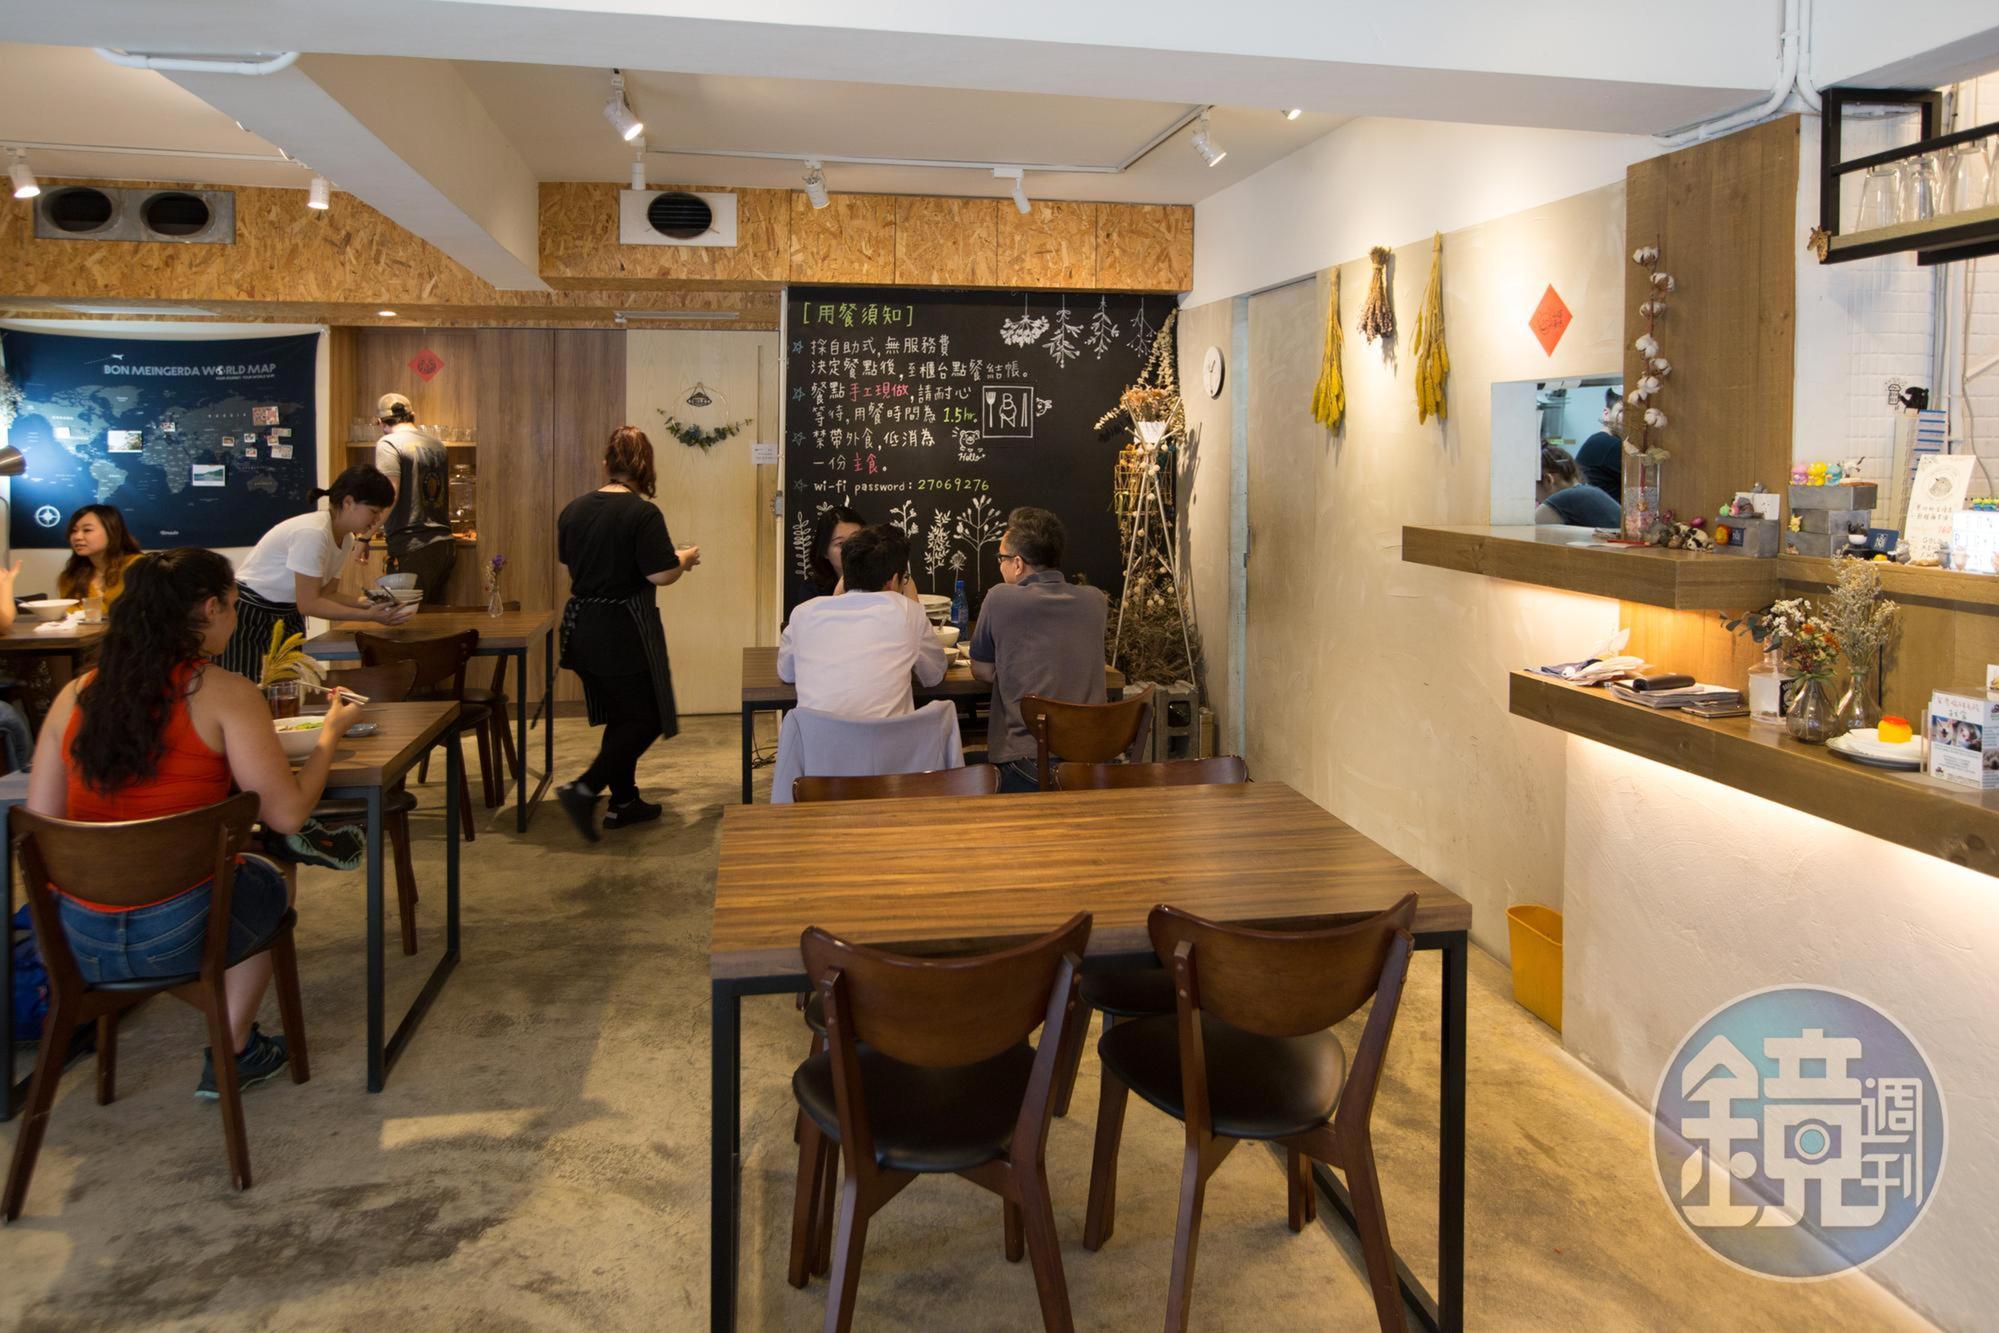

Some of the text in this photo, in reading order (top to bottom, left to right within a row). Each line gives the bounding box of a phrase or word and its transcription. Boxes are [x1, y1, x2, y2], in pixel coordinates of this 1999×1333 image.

[104, 365, 130, 375] BON
[131, 365, 200, 376] MEINGERDA
[247, 363, 276, 374] MAP
[814, 480, 847, 493] wi-fi
[918, 478, 990, 491] 27069276
